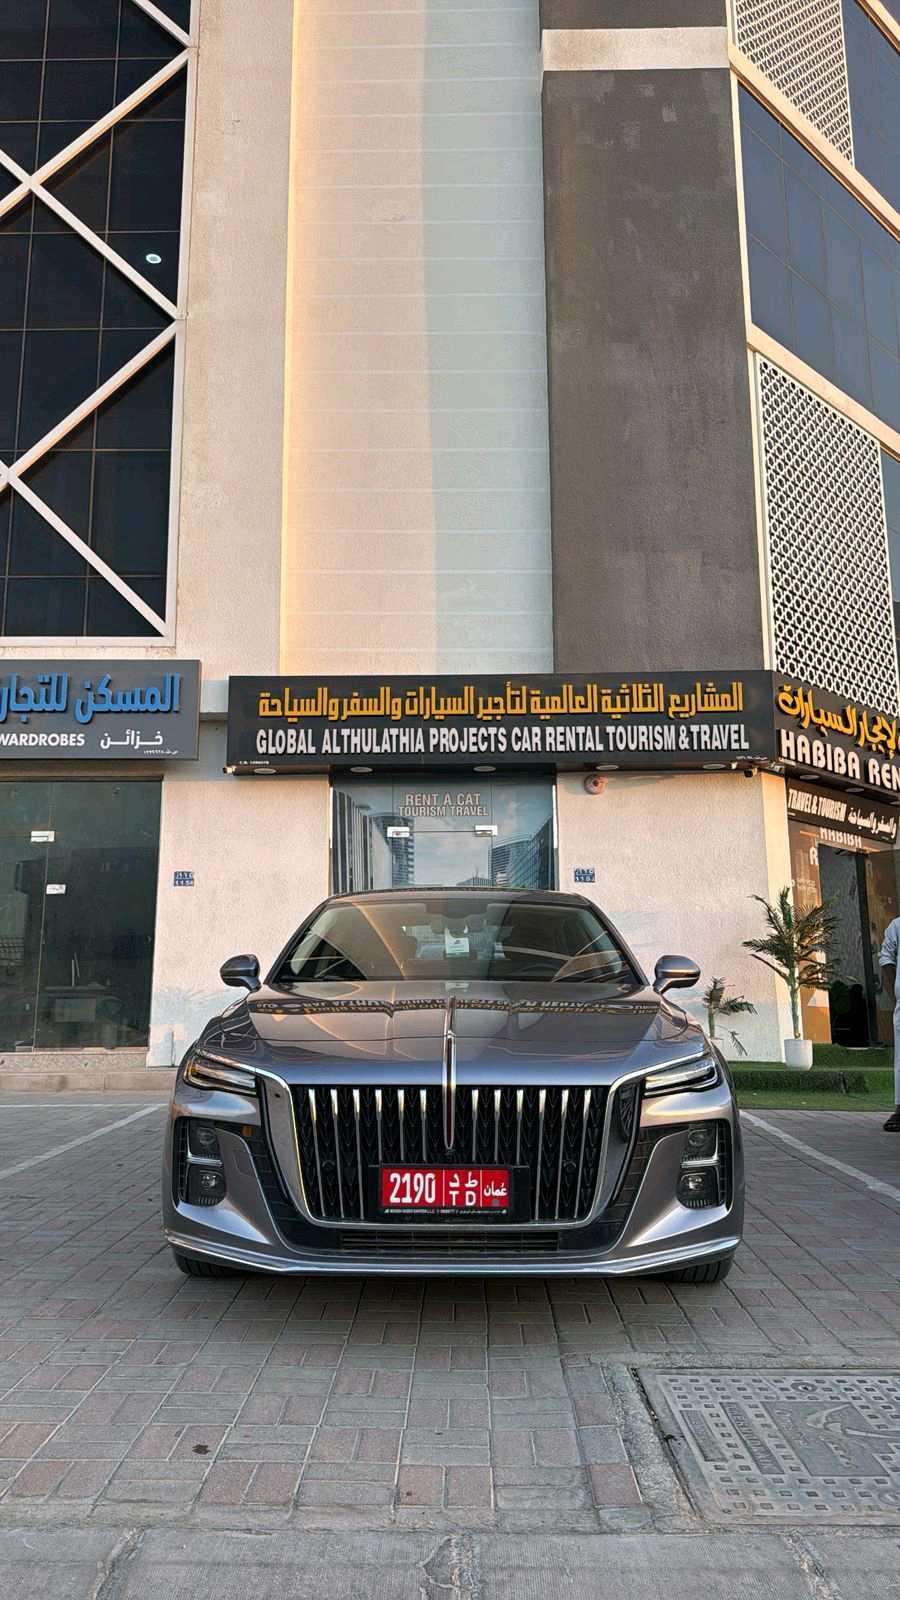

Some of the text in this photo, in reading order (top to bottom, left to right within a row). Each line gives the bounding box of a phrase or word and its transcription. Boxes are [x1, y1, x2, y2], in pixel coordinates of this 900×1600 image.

[74, 672, 181, 724] المسكن
[258, 687, 338, 723] والسياحة
[405, 686, 475, 721] السيارات
[476, 681, 527, 721] لتأجير
[530, 683, 599, 720] العالمية
[601, 683, 665, 719] الثلاثية
[668, 681, 744, 719] المشاريع
[778, 684, 857, 736] السيارات
[0, 732, 86, 747] WARDROBES
[100, 728, 164, 749] خزائن
[256, 728, 316, 754] GLOBAL
[322, 727, 425, 754] ALTHULATHIA
[429, 726, 507, 753] PROJECTS
[511, 726, 542, 752] CAR
[545, 725, 604, 752] RENTAL
[780, 728, 861, 780] HABIBA
[399, 806, 489, 816] TOURISM TRAVEL
[405, 793, 480, 806] RENT A CAT
[389, 1172, 436, 1204] 2190
[449, 1191, 476, 1206] T D
